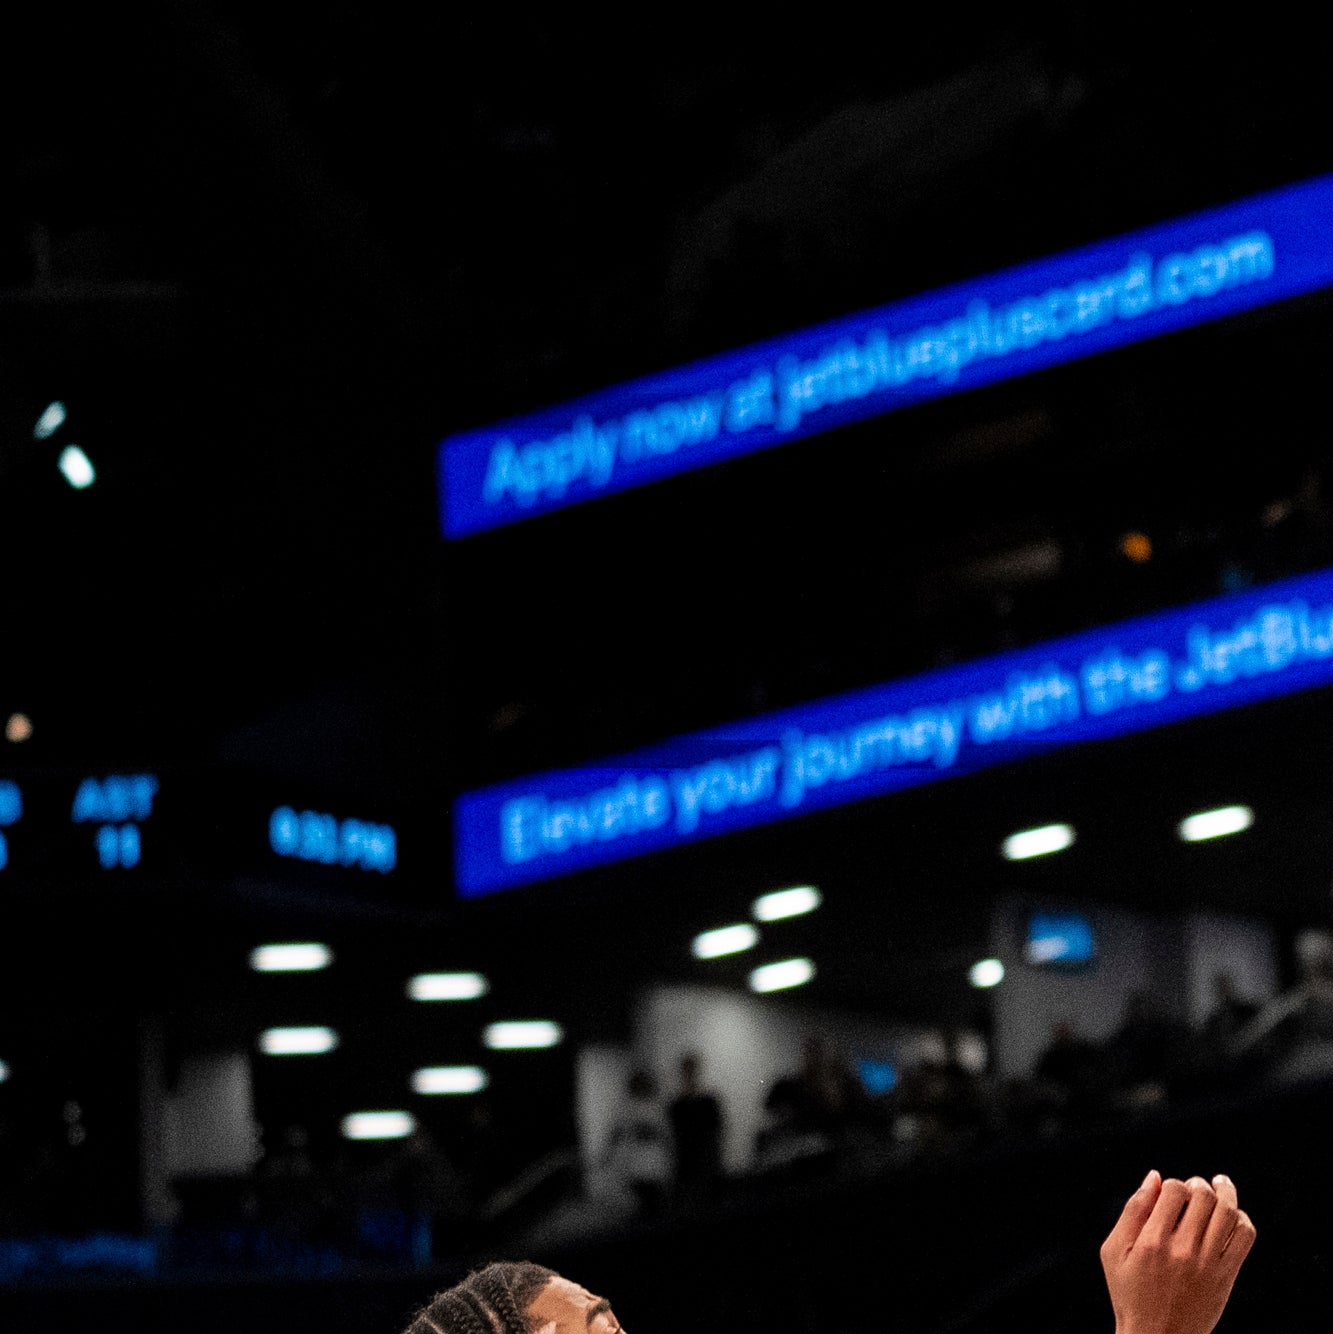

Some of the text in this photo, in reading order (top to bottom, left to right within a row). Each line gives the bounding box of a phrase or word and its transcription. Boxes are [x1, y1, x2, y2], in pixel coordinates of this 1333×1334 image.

[485, 417, 620, 506] Apply
[620, 395, 722, 462] now
[725, 368, 774, 433] at
[502, 774, 671, 864] Elevate
[670, 746, 780, 834] your
[780, 704, 964, 807] journey
[966, 664, 1080, 744] with
[1080, 645, 1171, 715] the
